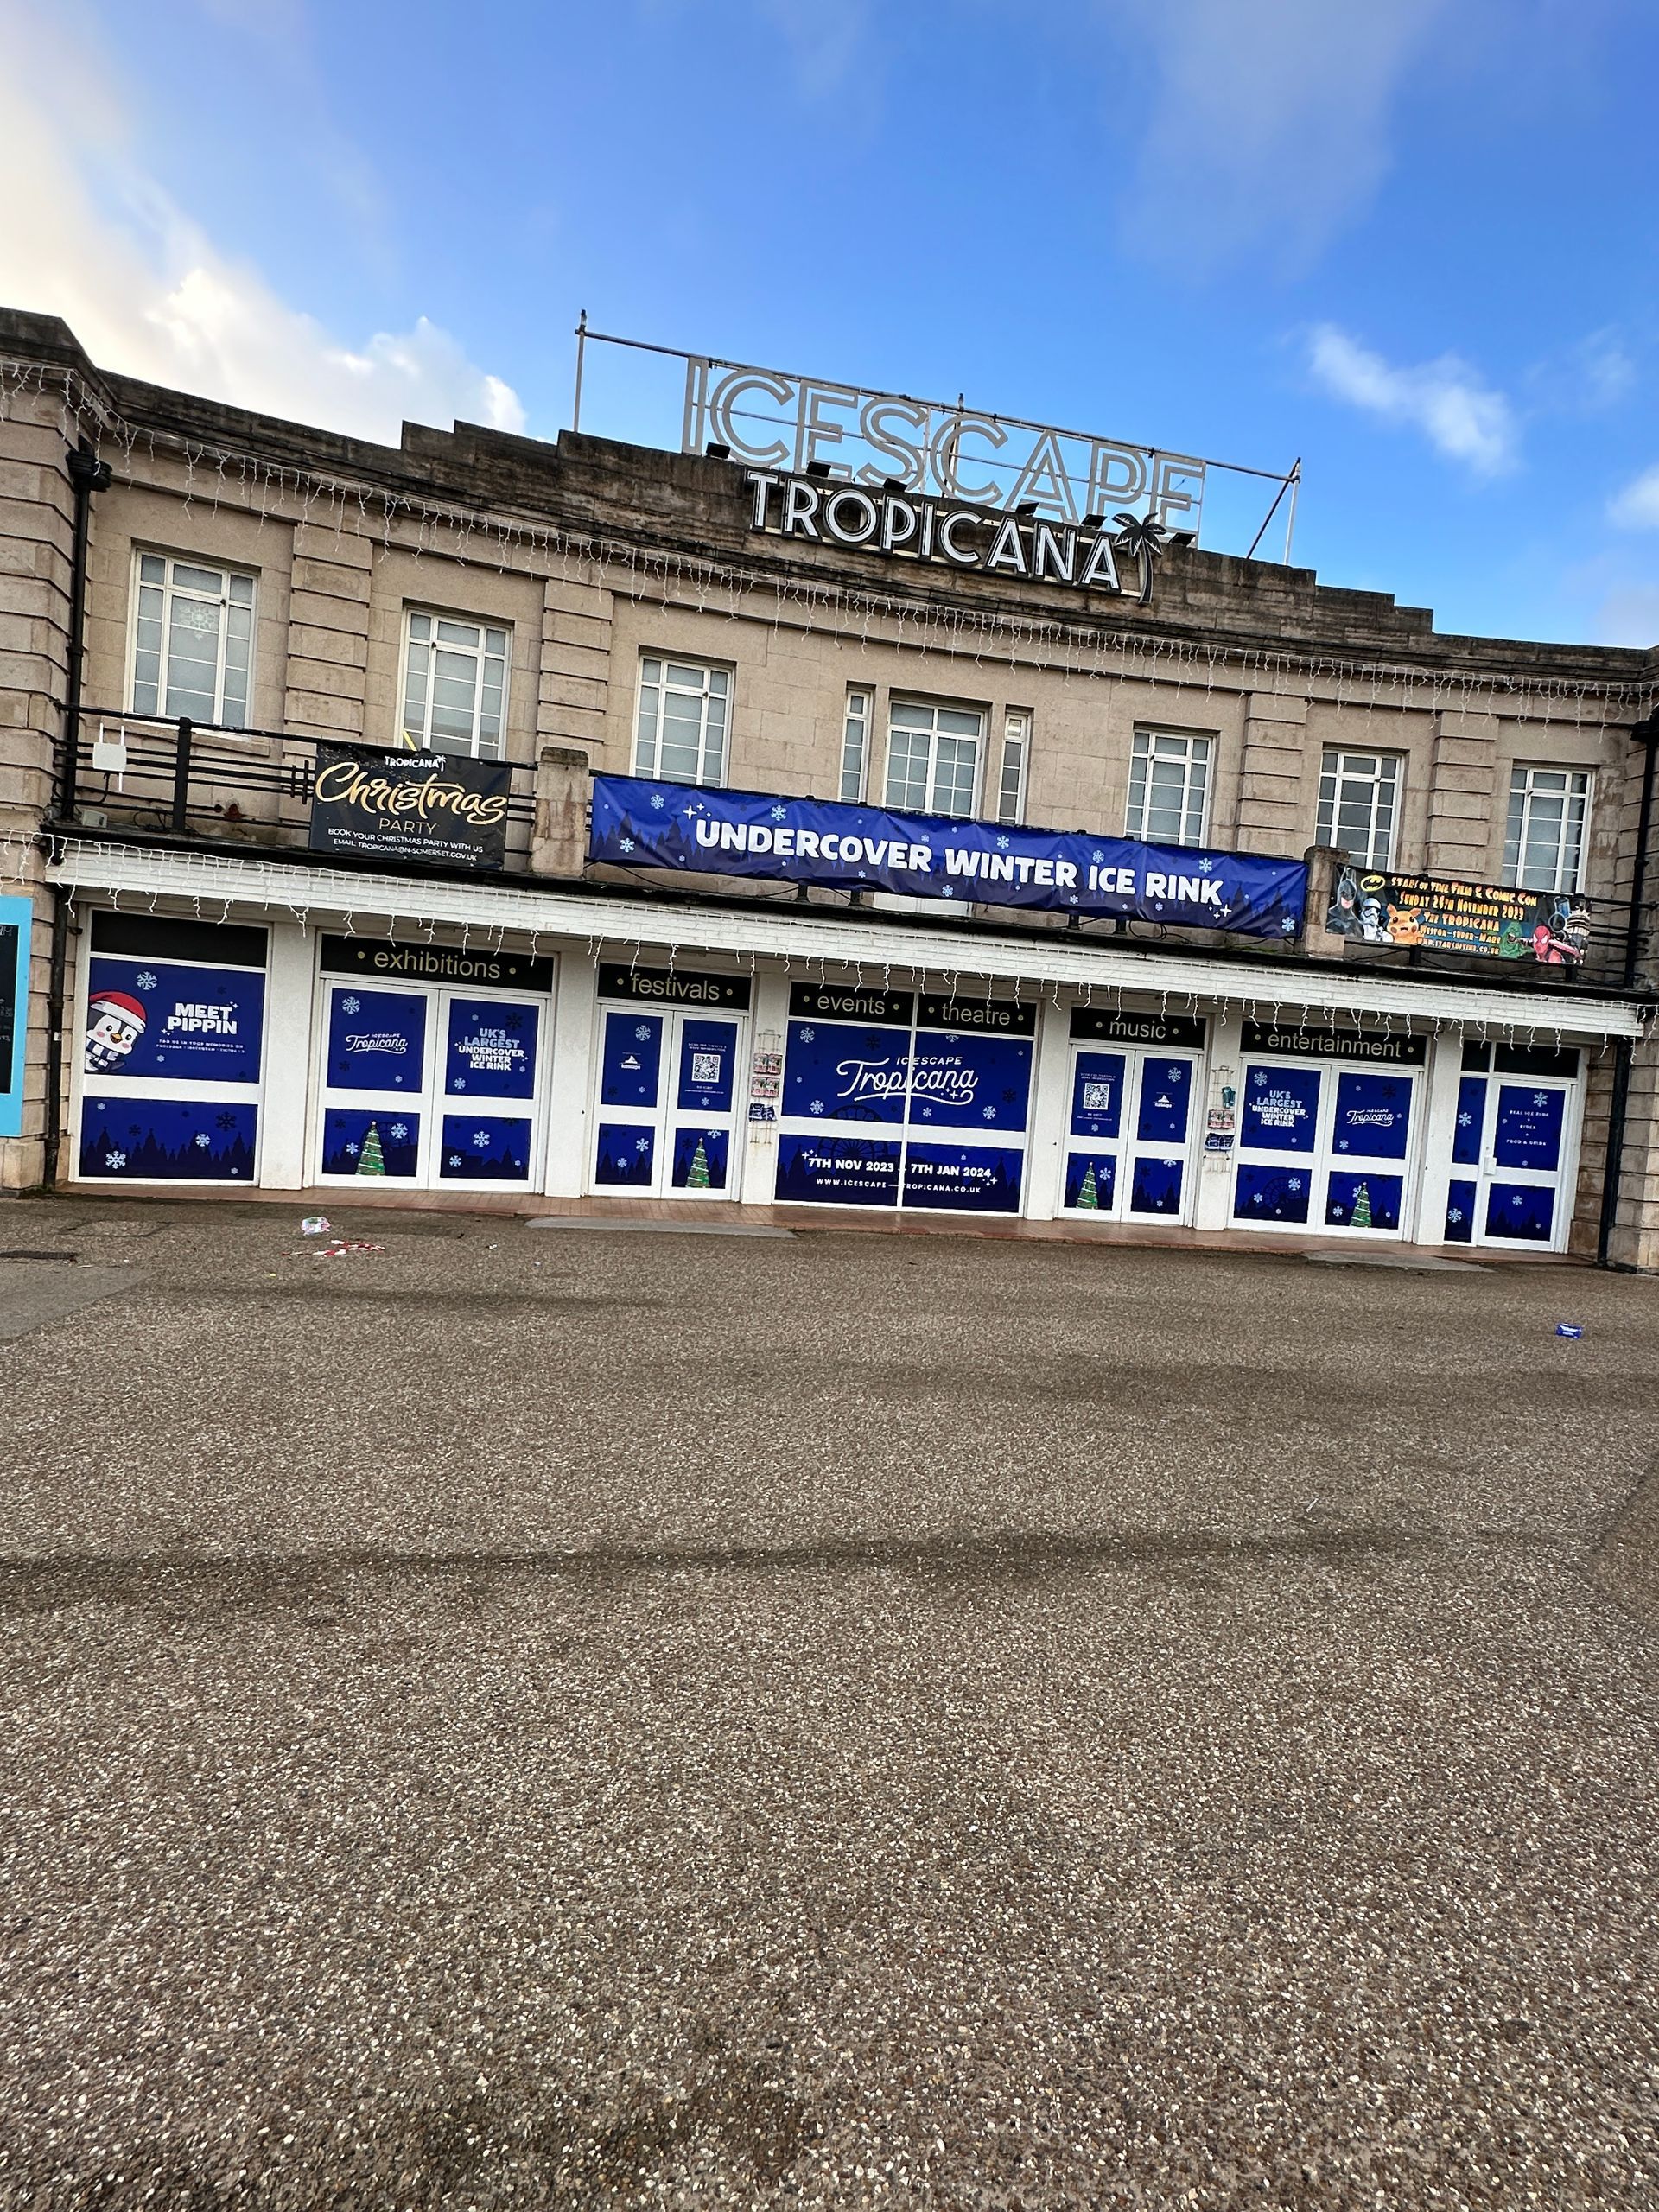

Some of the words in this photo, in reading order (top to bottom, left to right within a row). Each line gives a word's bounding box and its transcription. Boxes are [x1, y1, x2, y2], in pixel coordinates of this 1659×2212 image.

[682, 354, 1207, 546] ICESCAPE
[746, 468, 1122, 593] TROPICANA
[385, 755, 440, 768] TROPICANA
[315, 761, 508, 825] Christmas
[378, 817, 437, 835] PARTY
[328, 828, 352, 836] BOOK
[353, 831, 376, 841] YOUR
[377, 834, 422, 845] CHRISTMAS
[423, 838, 448, 848] PARTY
[449, 842, 471, 851] WITH
[696, 818, 932, 874] UNDERCOVER
[944, 848, 1077, 888] WINTER
[1088, 865, 1136, 895] ICE
[1145, 872, 1224, 906] RINK
[1502, 904, 1525, 921] 2023
[374, 949, 501, 979] exhibitions
[631, 973, 721, 1001] festivals
[175, 1002, 233, 1020] MEET
[817, 995, 886, 1015] events
[942, 1003, 1011, 1026] theatre
[168, 1015, 238, 1035] PIPPIN
[480, 1027, 506, 1038] UK'S
[1109, 1019, 1166, 1039] music
[346, 1033, 409, 1053] Tropicana
[458, 1045, 524, 1058] UNDERCOVER
[464, 1036, 520, 1049] LARGEST
[1268, 1032, 1402, 1058] entertainment
[471, 1053, 512, 1064] WINTER
[486, 1062, 512, 1071] RINK
[896, 1056, 963, 1065] ICESCAPE
[1256, 1096, 1302, 1109] LARGEST
[1268, 1090, 1291, 1099] UK'S
[1252, 1104, 1306, 1116] UNDERCOVER
[1262, 1112, 1295, 1122] WINTER
[808, 1157, 831, 1169] 7TH
[835, 1159, 862, 1170] NOV
[866, 1160, 894, 1173] 2023
[910, 1163, 933, 1174] 7TH
[936, 1166, 960, 1176] JAN
[963, 1166, 992, 1178] 2024
[816, 1178, 982, 1193] WWW.ICESCAPE-ROPICANA.CO.UK
